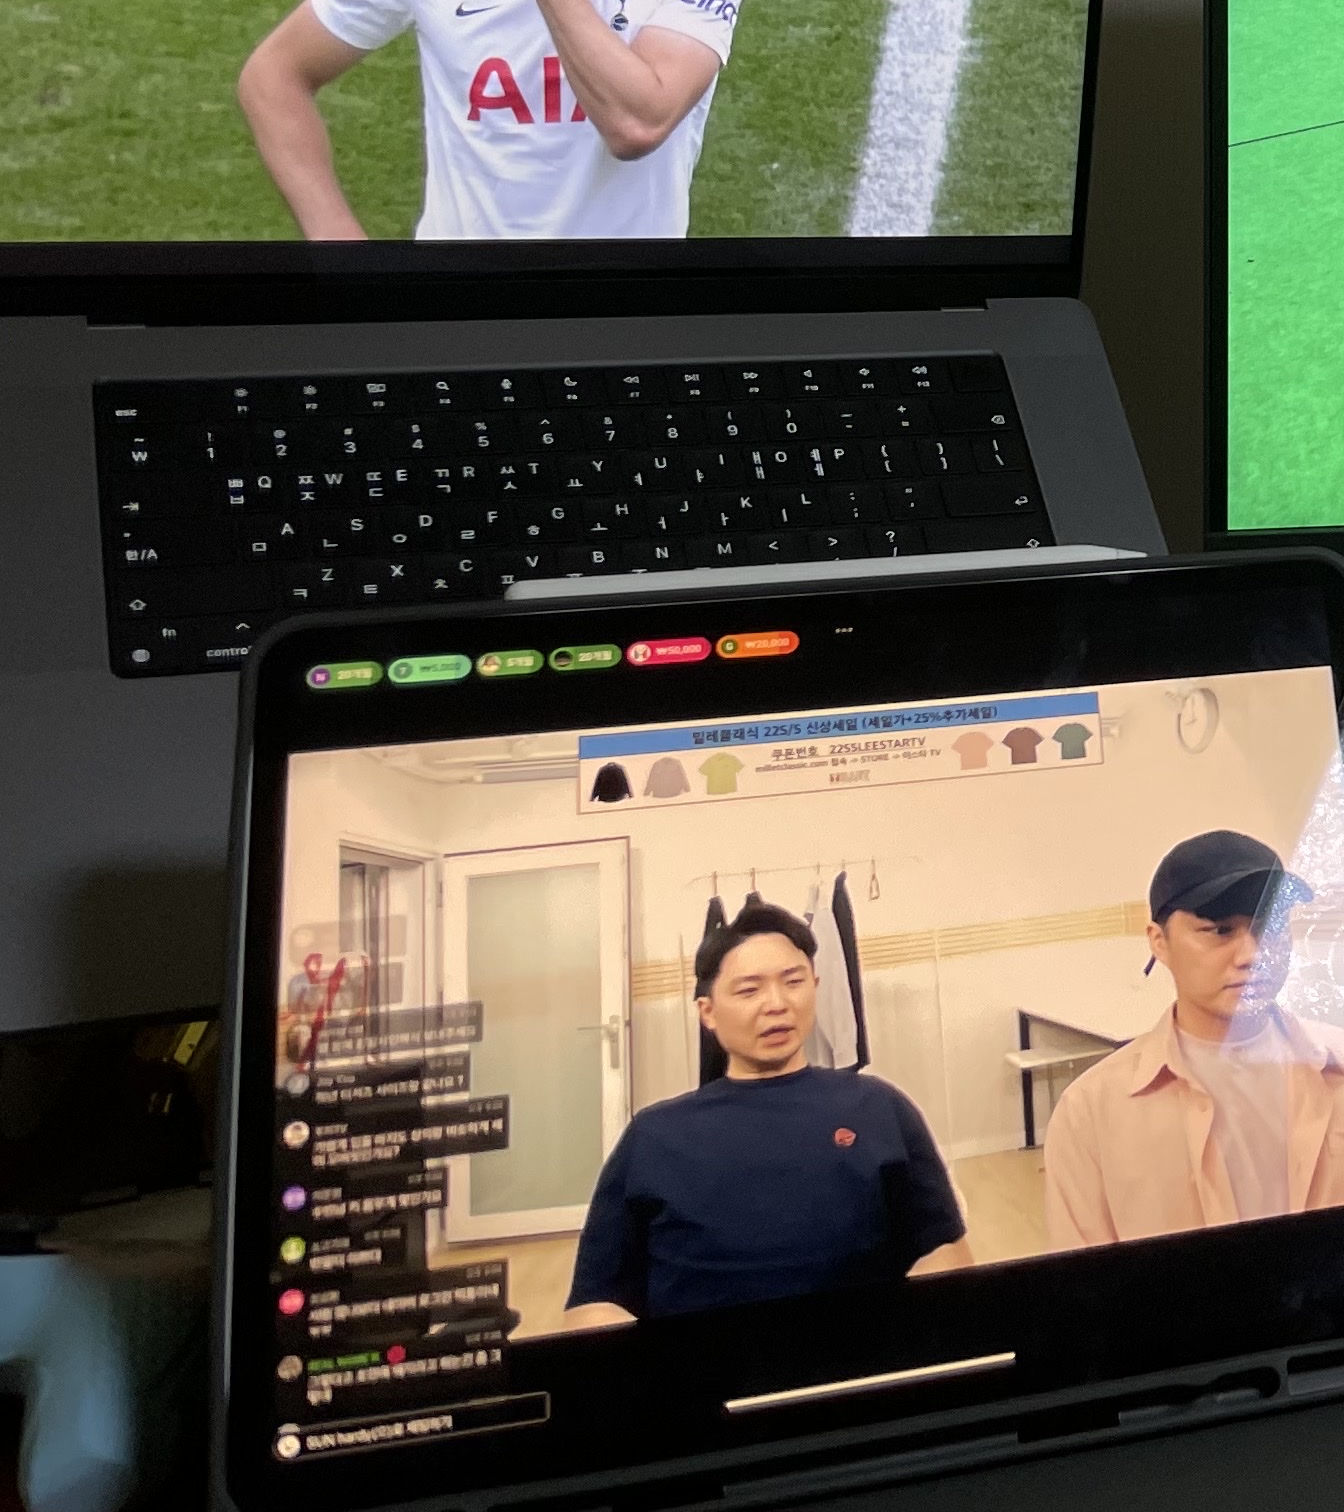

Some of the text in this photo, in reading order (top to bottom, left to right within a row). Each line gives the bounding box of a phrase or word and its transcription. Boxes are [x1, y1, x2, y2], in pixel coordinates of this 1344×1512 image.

[467, 56, 590, 124] AI
[668, 428, 678, 438] 8
[727, 425, 738, 435] 9
[787, 423, 797, 433] 0
[478, 436, 489, 447] 5
[543, 433, 554, 444] 6
[606, 431, 615, 441] 7
[344, 442, 356, 453] 3
[412, 439, 423, 449] 4
[207, 448, 214, 458] 1
[276, 444, 287, 457] 2
[834, 449, 844, 459] P
[775, 452, 787, 462] O
[528, 463, 539, 474] T
[593, 461, 603, 471] Y
[655, 458, 666, 468] U
[396, 470, 407, 481] E
[463, 466, 474, 477] R
[258, 476, 271, 488] Q
[324, 474, 343, 484] W
[741, 497, 752, 508] K
[801, 494, 811, 504] L
[616, 504, 629, 516] H
[680, 501, 688, 512] J
[488, 511, 498, 522] F
[552, 508, 564, 519] G
[351, 519, 363, 530] S
[419, 515, 432, 527] D
[281, 523, 294, 535] A
[656, 547, 668, 558] N
[718, 543, 732, 554] M
[526, 556, 538, 567] V
[593, 551, 604, 562] B
[391, 565, 404, 576] X
[460, 560, 473, 572] C
[322, 568, 334, 581] Z
